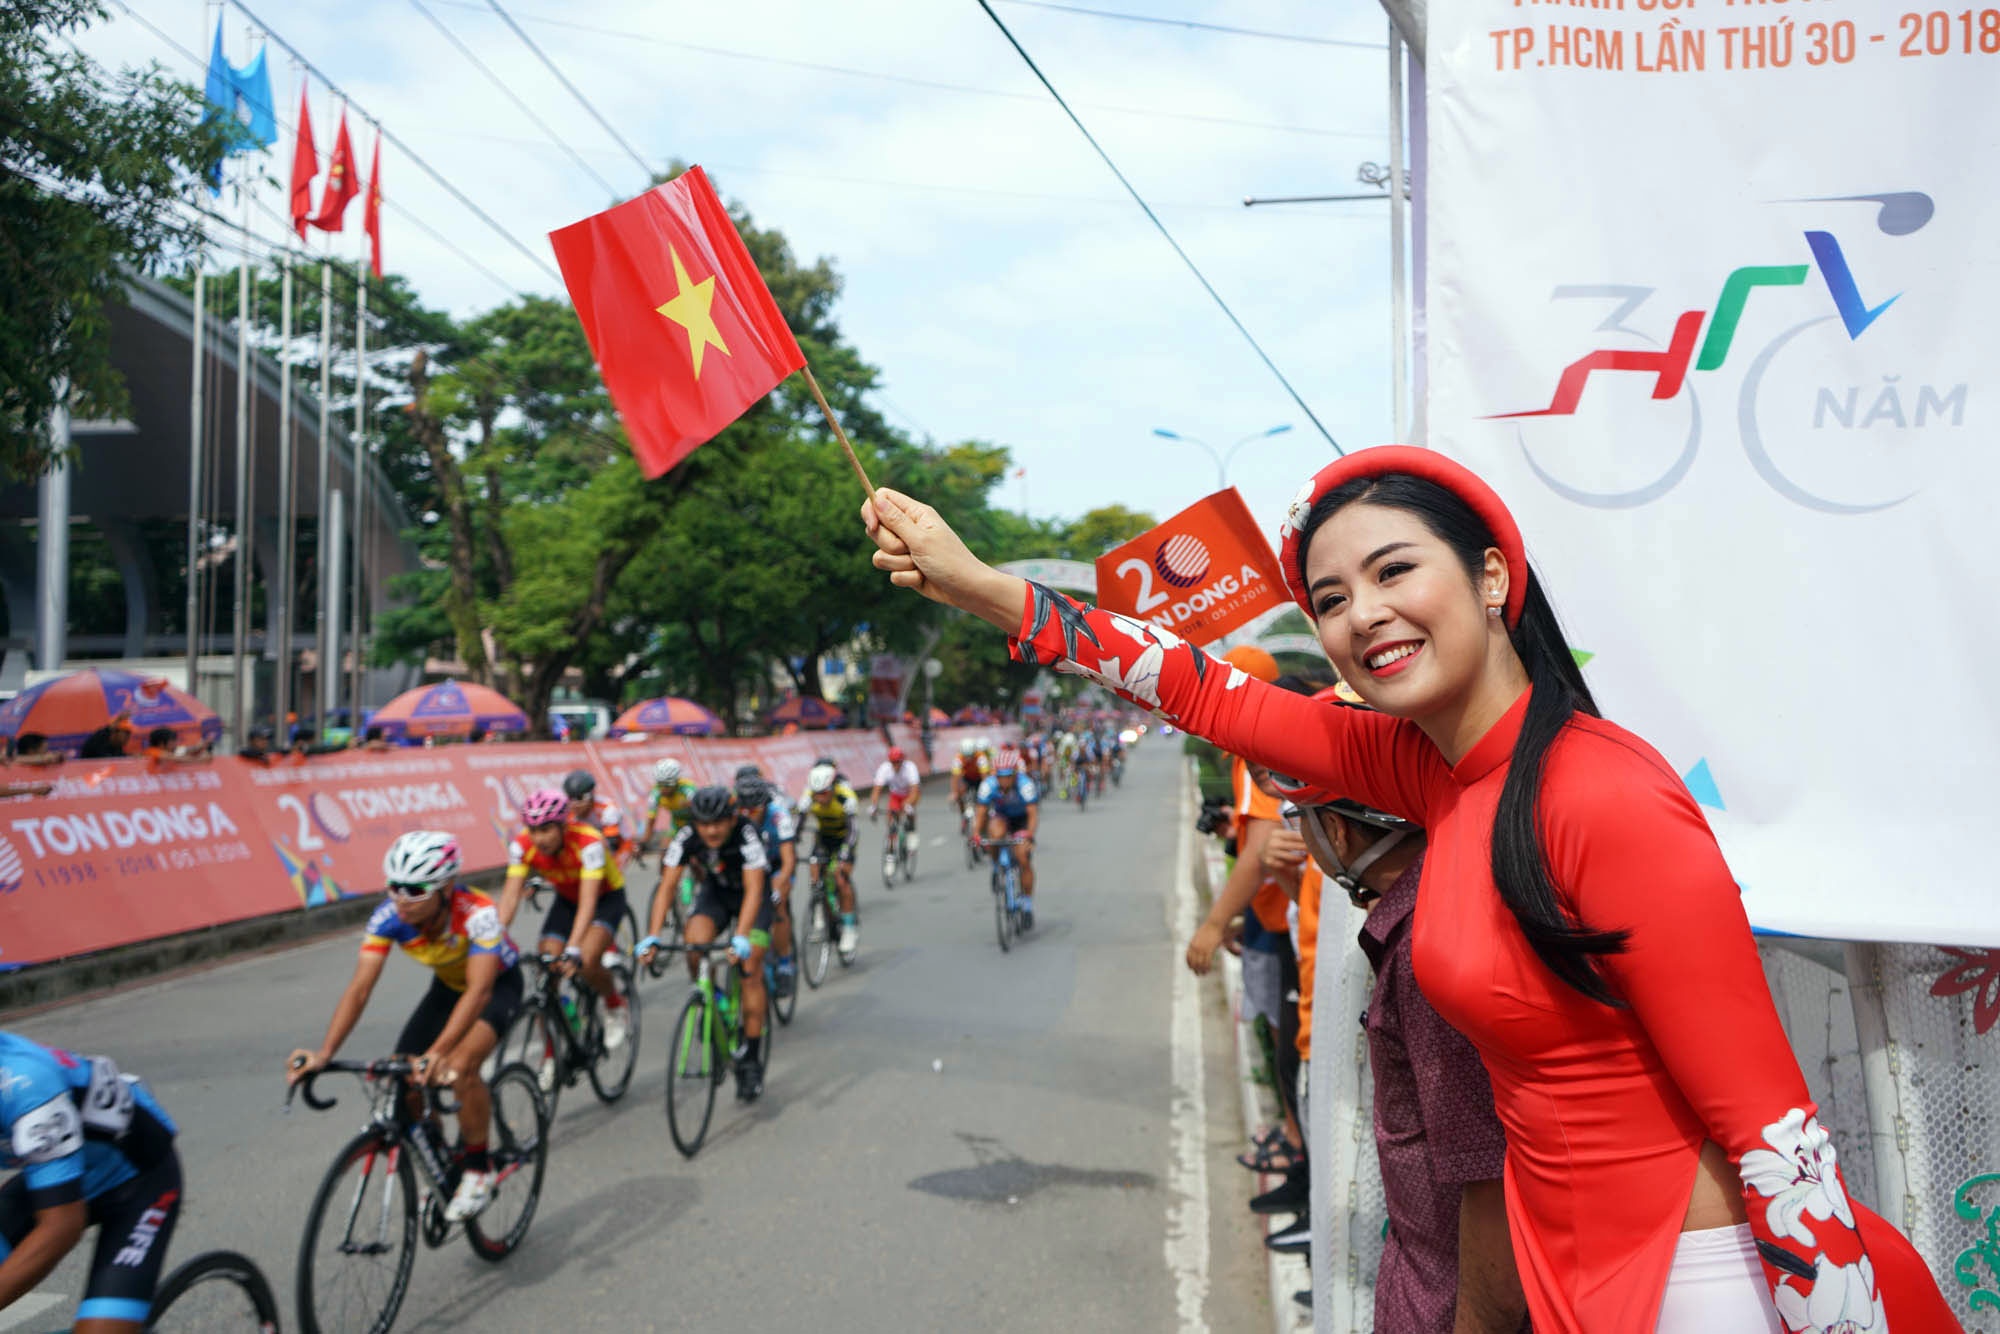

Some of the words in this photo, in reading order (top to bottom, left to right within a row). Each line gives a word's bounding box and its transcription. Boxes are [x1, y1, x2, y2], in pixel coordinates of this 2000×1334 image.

[1489, 25, 1623, 71] TP.HCM
[1635, 17, 1705, 72] LẦN
[1717, 15, 1794, 70] THỨ
[1805, 20, 1856, 66] 30
[1900, 9, 2000, 57] 2018
[1812, 375, 1968, 429] NĂM
[1171, 574, 1240, 622] DONG
